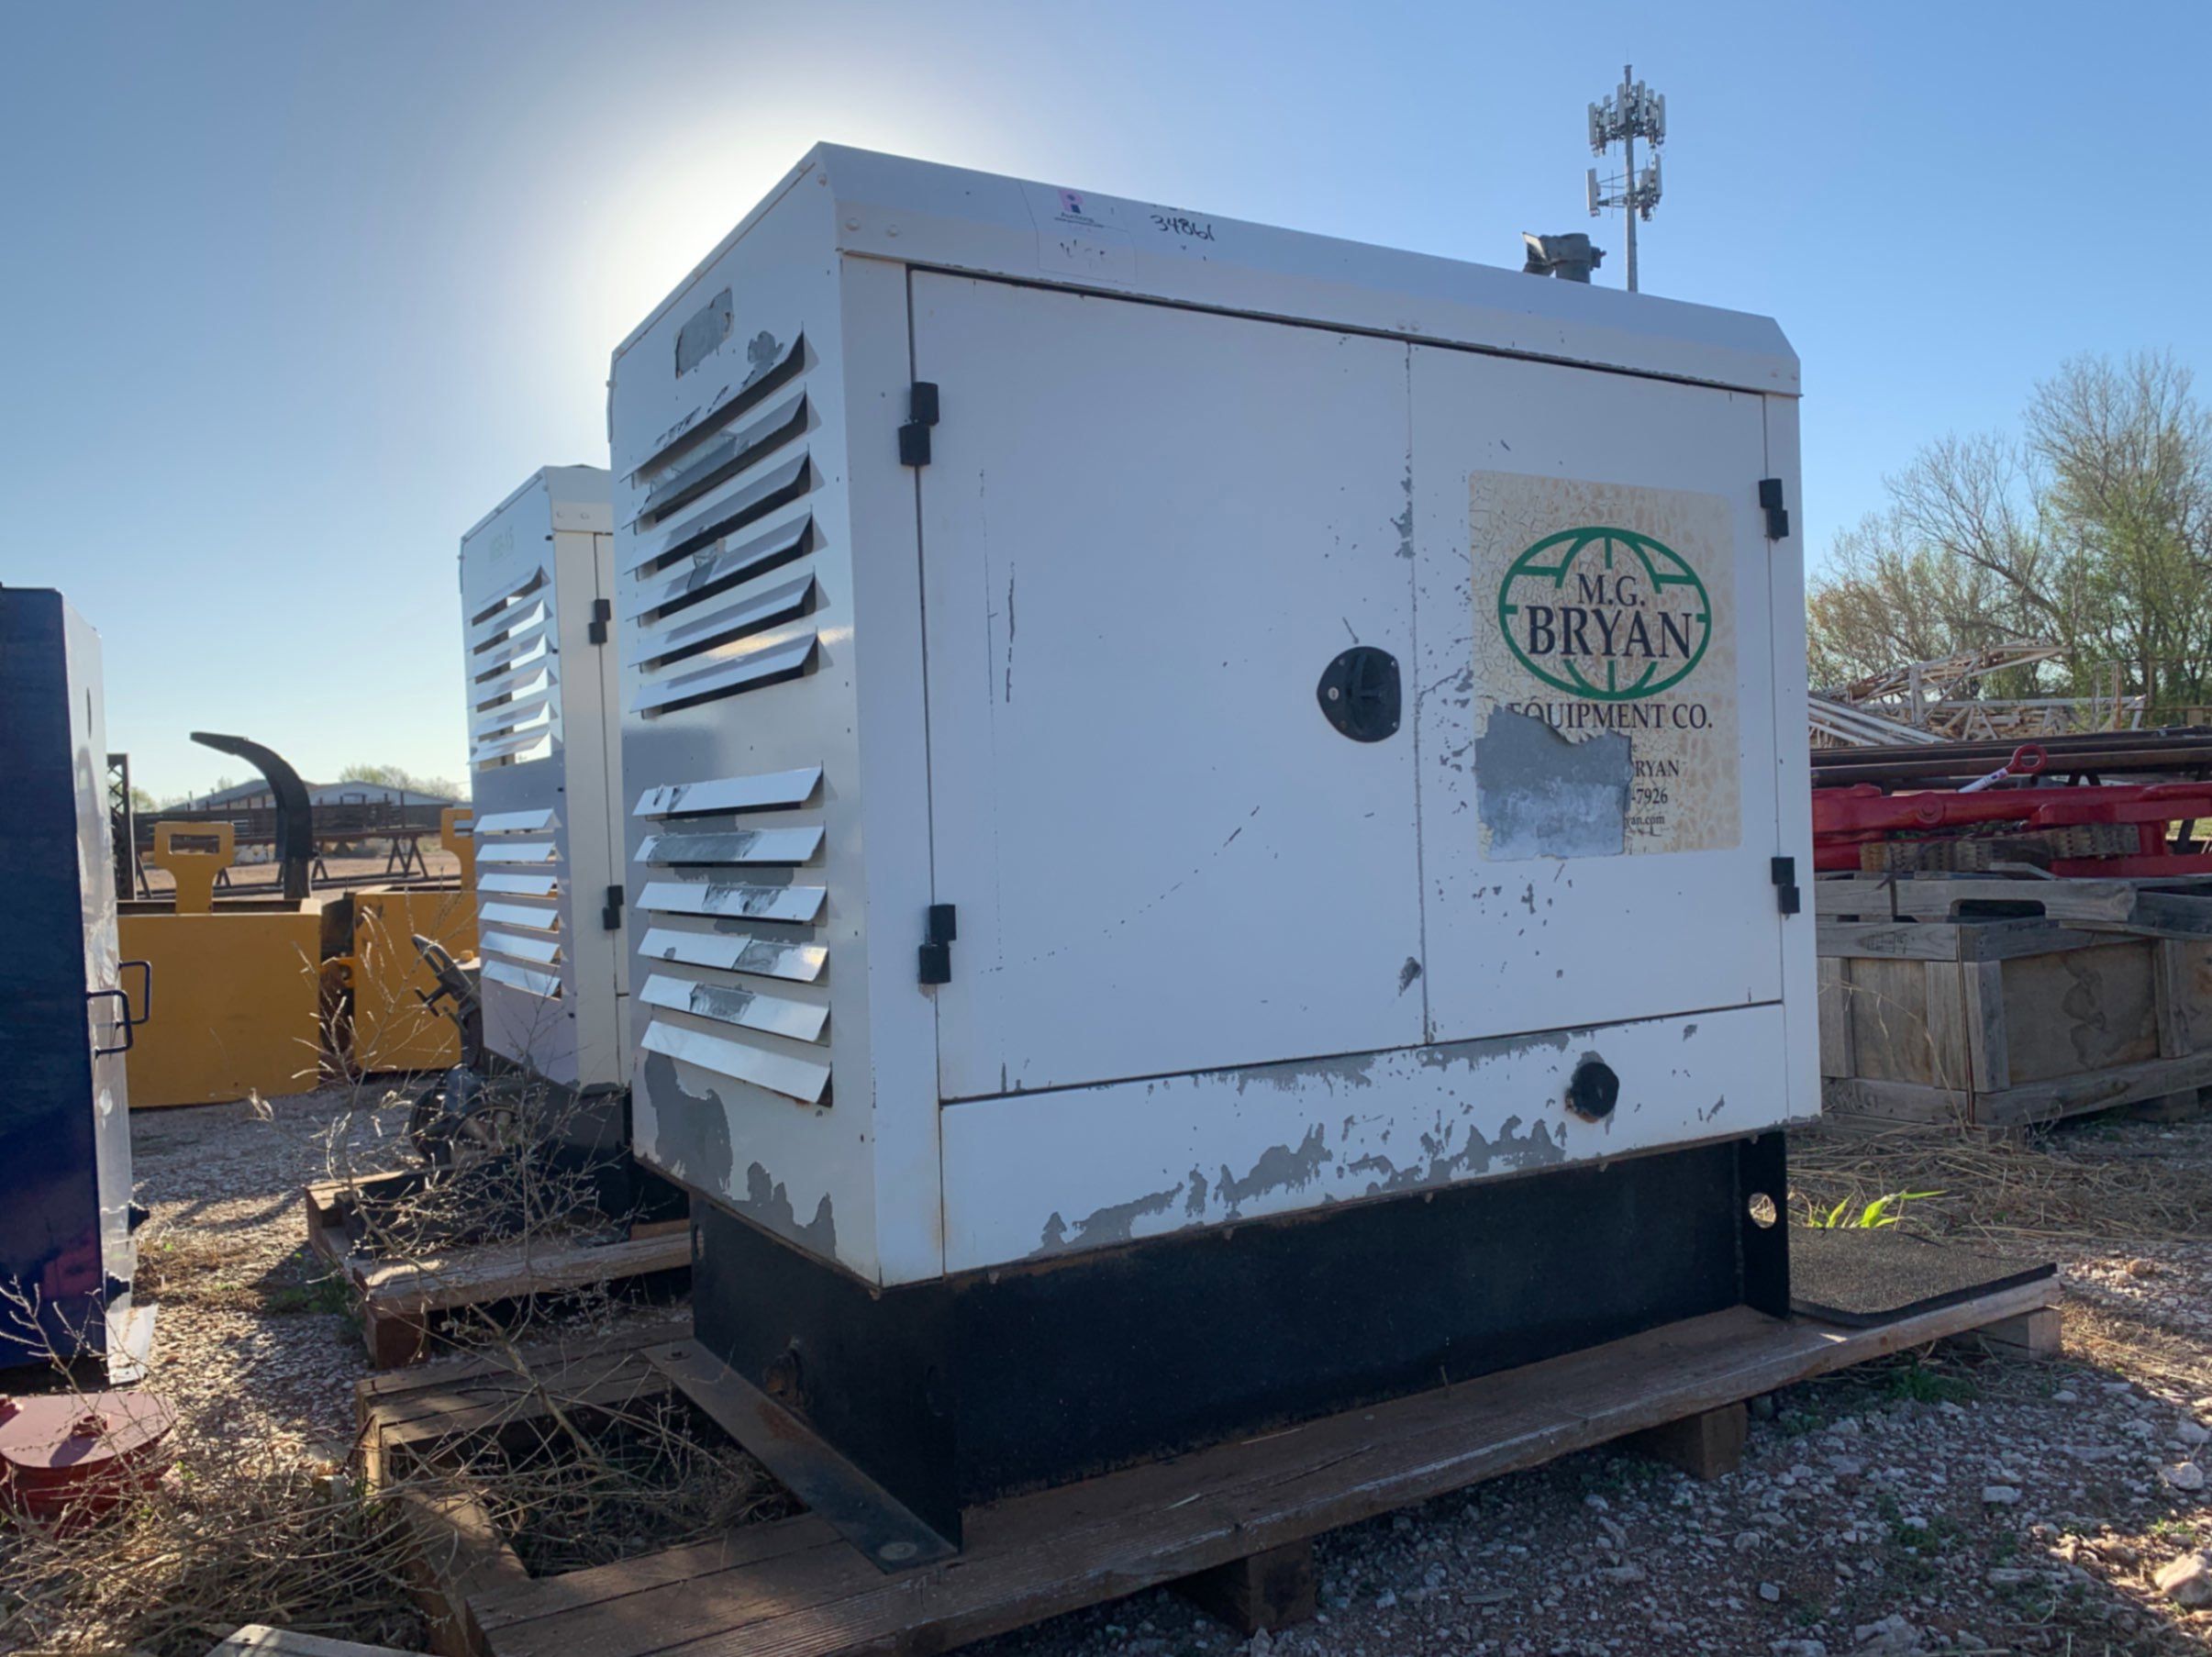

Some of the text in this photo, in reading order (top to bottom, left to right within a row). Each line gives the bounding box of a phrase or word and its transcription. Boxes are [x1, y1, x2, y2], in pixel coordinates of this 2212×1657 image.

[1576, 573, 1646, 606] M.G.
[1525, 606, 1693, 659] BRYAN
[1673, 703, 1714, 729] CO.
